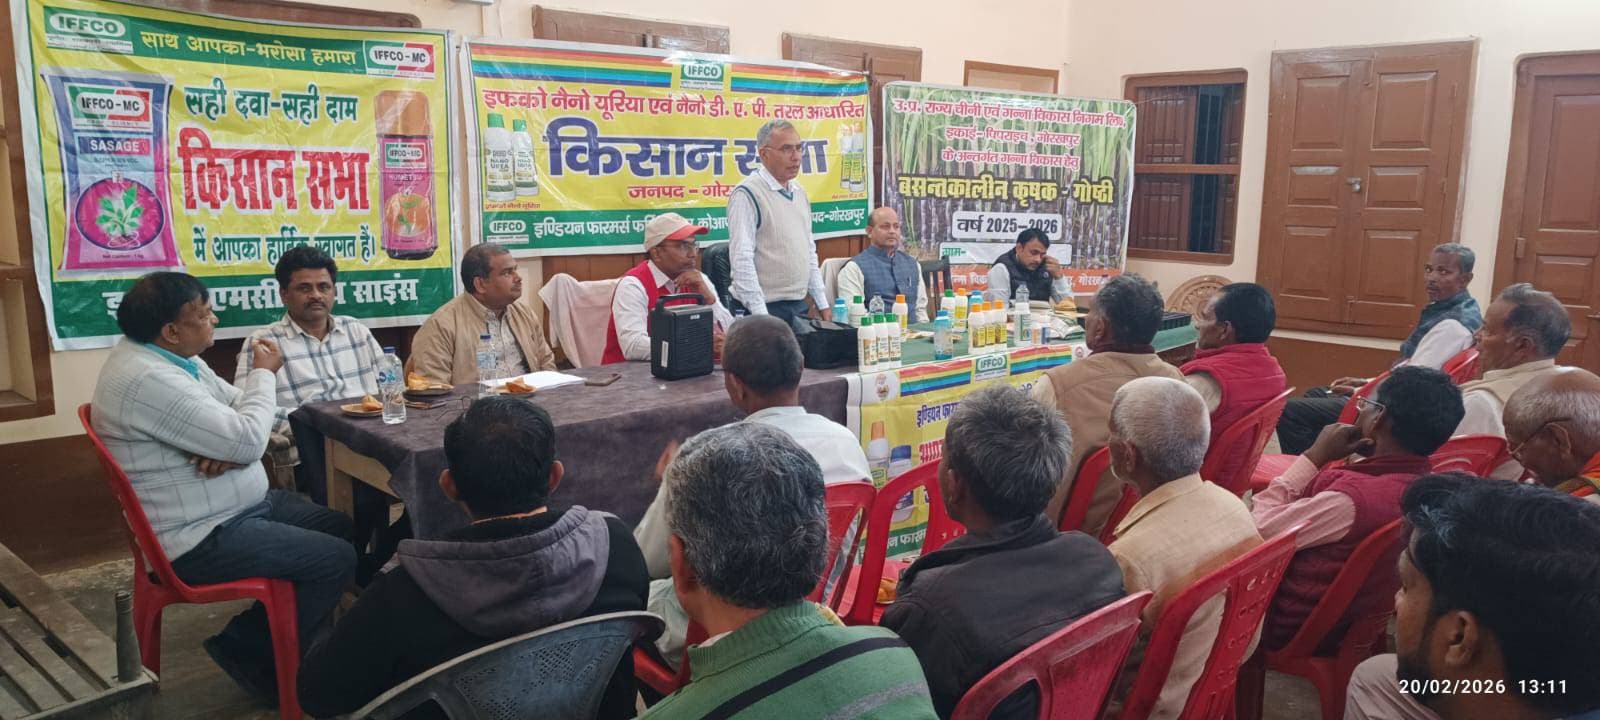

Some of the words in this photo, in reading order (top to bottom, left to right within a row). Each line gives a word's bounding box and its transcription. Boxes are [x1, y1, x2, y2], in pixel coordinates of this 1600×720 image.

[58, 16, 118, 34] IFFCO
[140, 31, 178, 49] साथ
[311, 48, 356, 65] हमारा
[688, 64, 718, 77] IFFCO
[185, 78, 226, 120] सही
[326, 96, 358, 121] दाम
[483, 86, 547, 109] इफको
[551, 87, 590, 110] नैनो
[594, 90, 644, 120] यूरिया
[648, 95, 672, 114] एवं
[677, 95, 705, 114] नैनो
[709, 96, 729, 117] डी.
[752, 98, 770, 117] पी.
[774, 104, 803, 118] तरल
[807, 99, 864, 118] आधारित
[955, 100, 981, 116] चीनी
[1034, 107, 1070, 122] विकास
[1073, 109, 1104, 125] निगम
[90, 139, 139, 152] SASAGE
[543, 117, 727, 176] किसान
[177, 127, 297, 209] किसान
[302, 151, 370, 209] सभा
[629, 185, 685, 198] जनपद
[1013, 181, 1057, 207] कृषक
[493, 222, 522, 231] IFFCO
[533, 217, 585, 238] इण्डियन
[587, 213, 630, 235] फारमर्स
[957, 215, 984, 232] वर्ष
[193, 227, 206, 261] में
[212, 236, 260, 261] आपका
[351, 273, 419, 304] साइंस
[981, 357, 1003, 368] IFFCO
